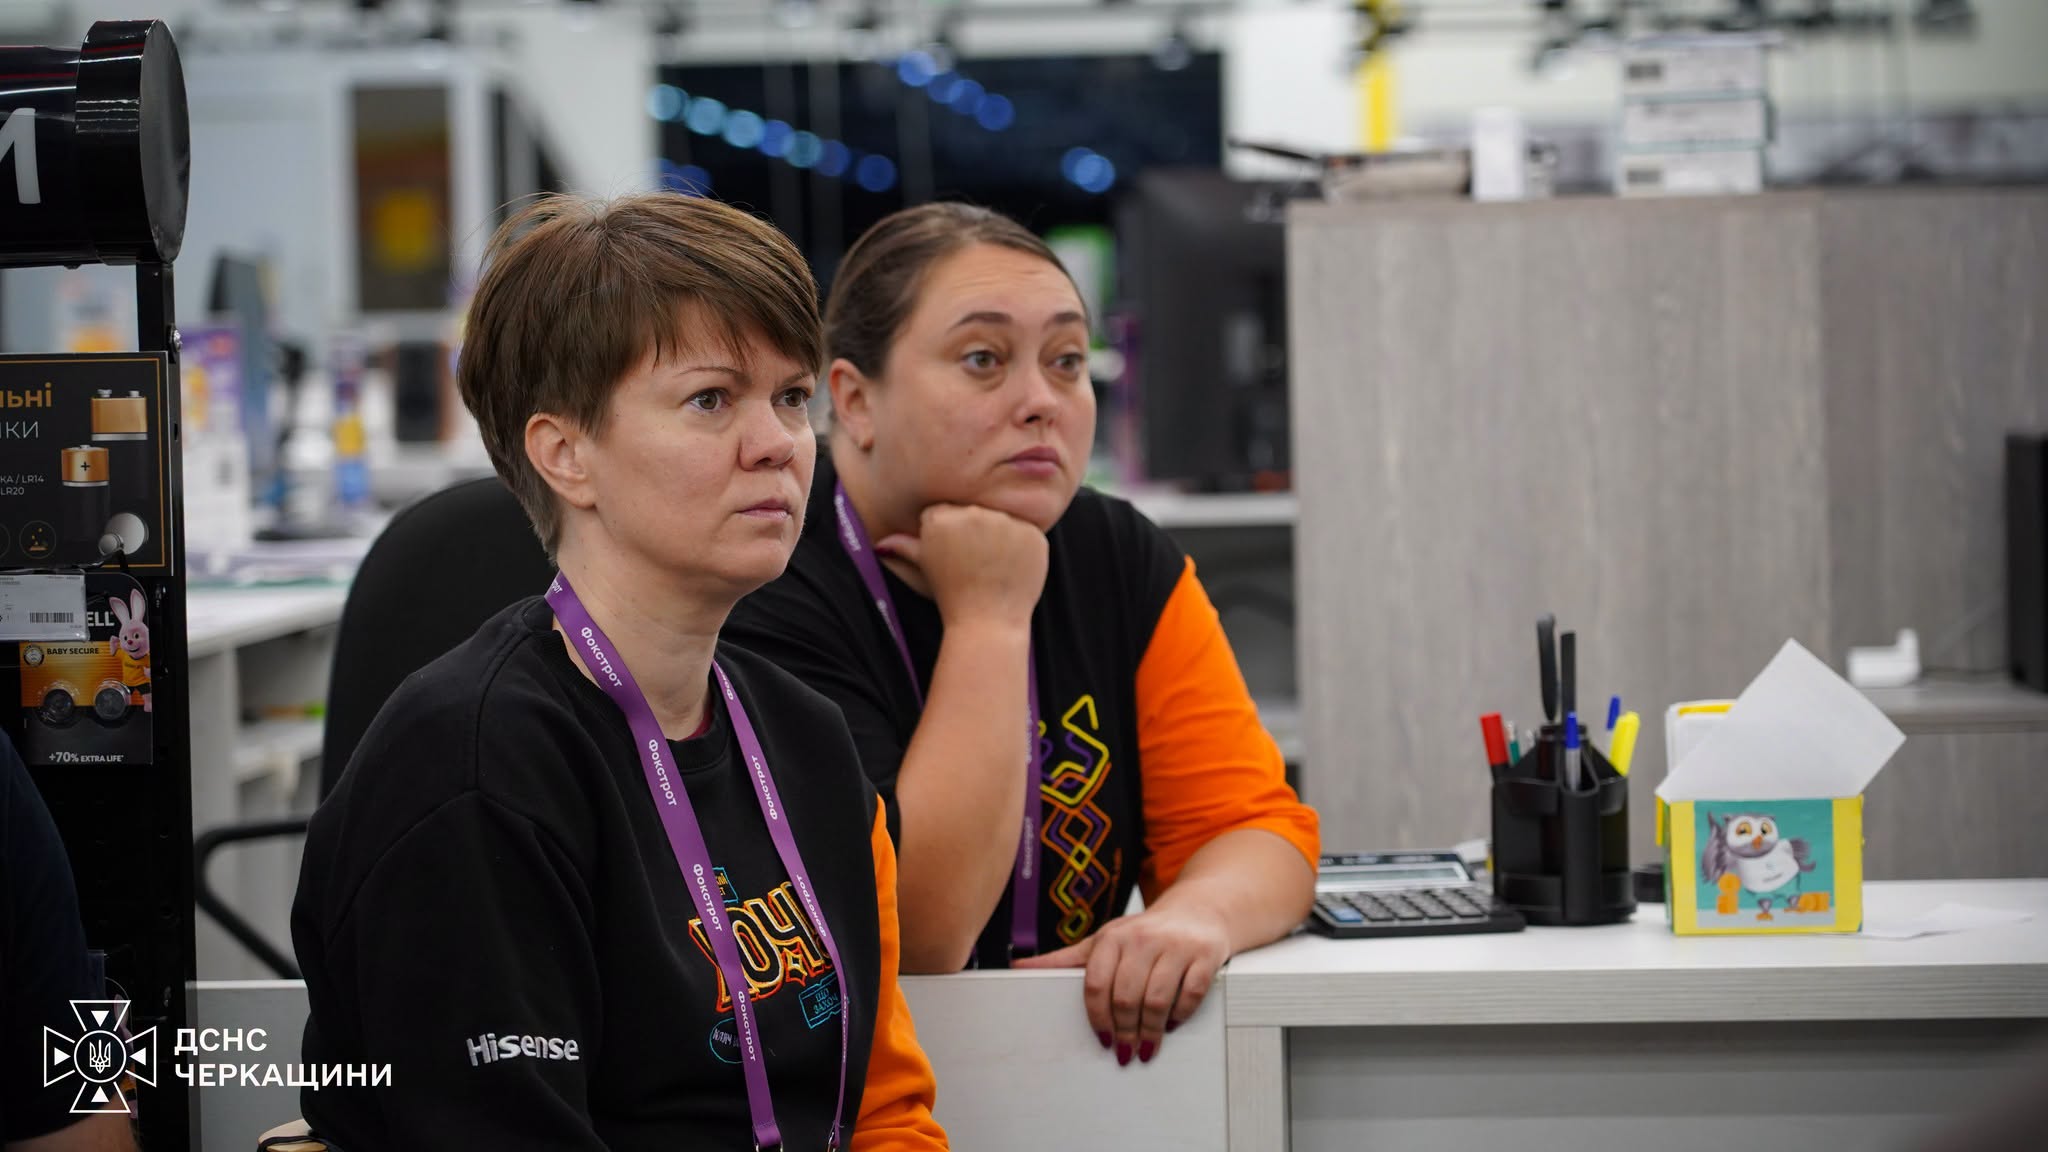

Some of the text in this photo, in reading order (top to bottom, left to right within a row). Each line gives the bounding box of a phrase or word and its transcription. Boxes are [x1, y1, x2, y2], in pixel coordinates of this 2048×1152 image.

[0, 382, 52, 408] ьні
[0, 486, 25, 496] LR20
[21, 475, 45, 484] LR14
[46, 647, 100, 655] BABY SECURE
[580, 626, 622, 689] Фокстрот
[49, 751, 79, 763] +70%
[80, 754, 106, 763] EXTRA
[648, 738, 678, 807] Фокстрот
[751, 754, 778, 821] Фокстрот
[693, 863, 723, 932] Фокстрот
[796, 874, 828, 938] Фокстрот
[466, 1032, 580, 1066] Hisense
[738, 990, 756, 1061] Фокстрот
